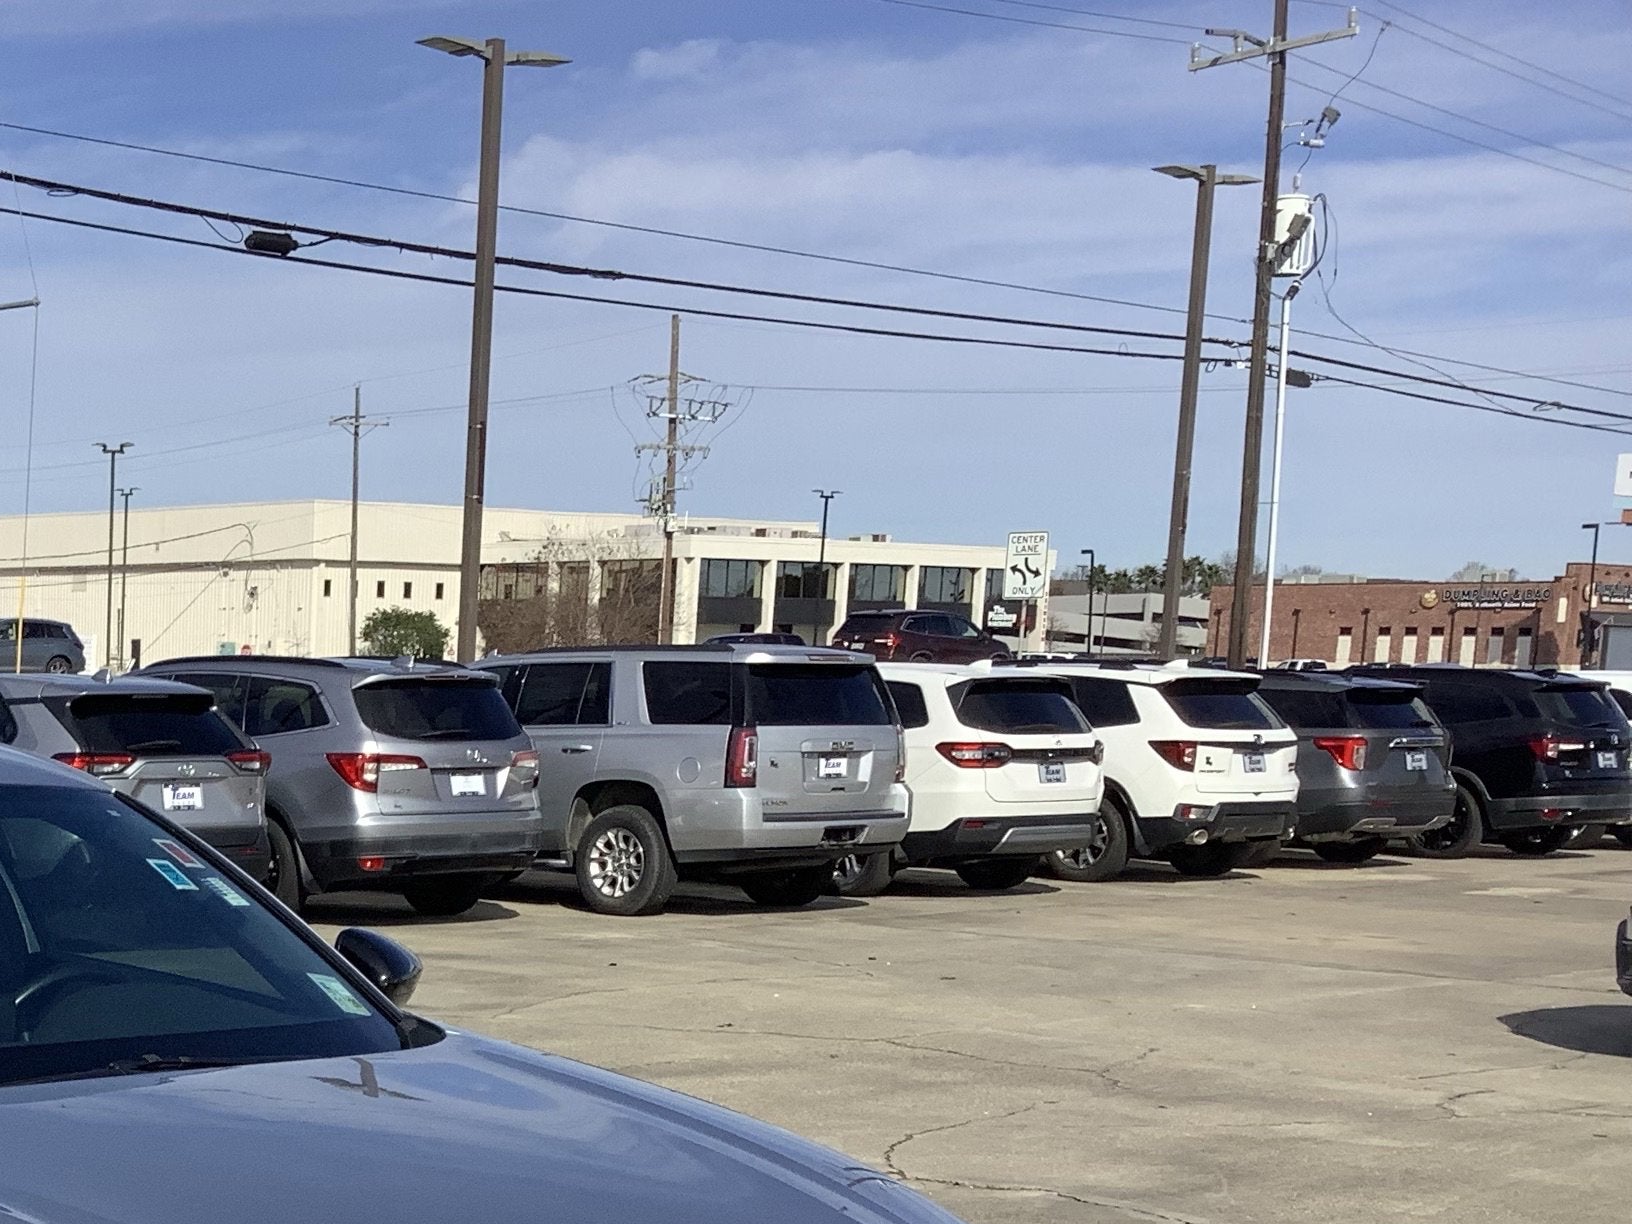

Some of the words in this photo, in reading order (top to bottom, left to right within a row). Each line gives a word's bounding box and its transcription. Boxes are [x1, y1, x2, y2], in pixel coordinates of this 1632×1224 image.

[1011, 535, 1046, 544] CENTER
[1015, 545, 1040, 553] LANE
[1012, 587, 1036, 595] ONLY
[1443, 589, 1509, 600] DUMPLING
[1512, 589, 1520, 599] &
[1525, 589, 1551, 599] BAO
[171, 785, 195, 800] TEAM
